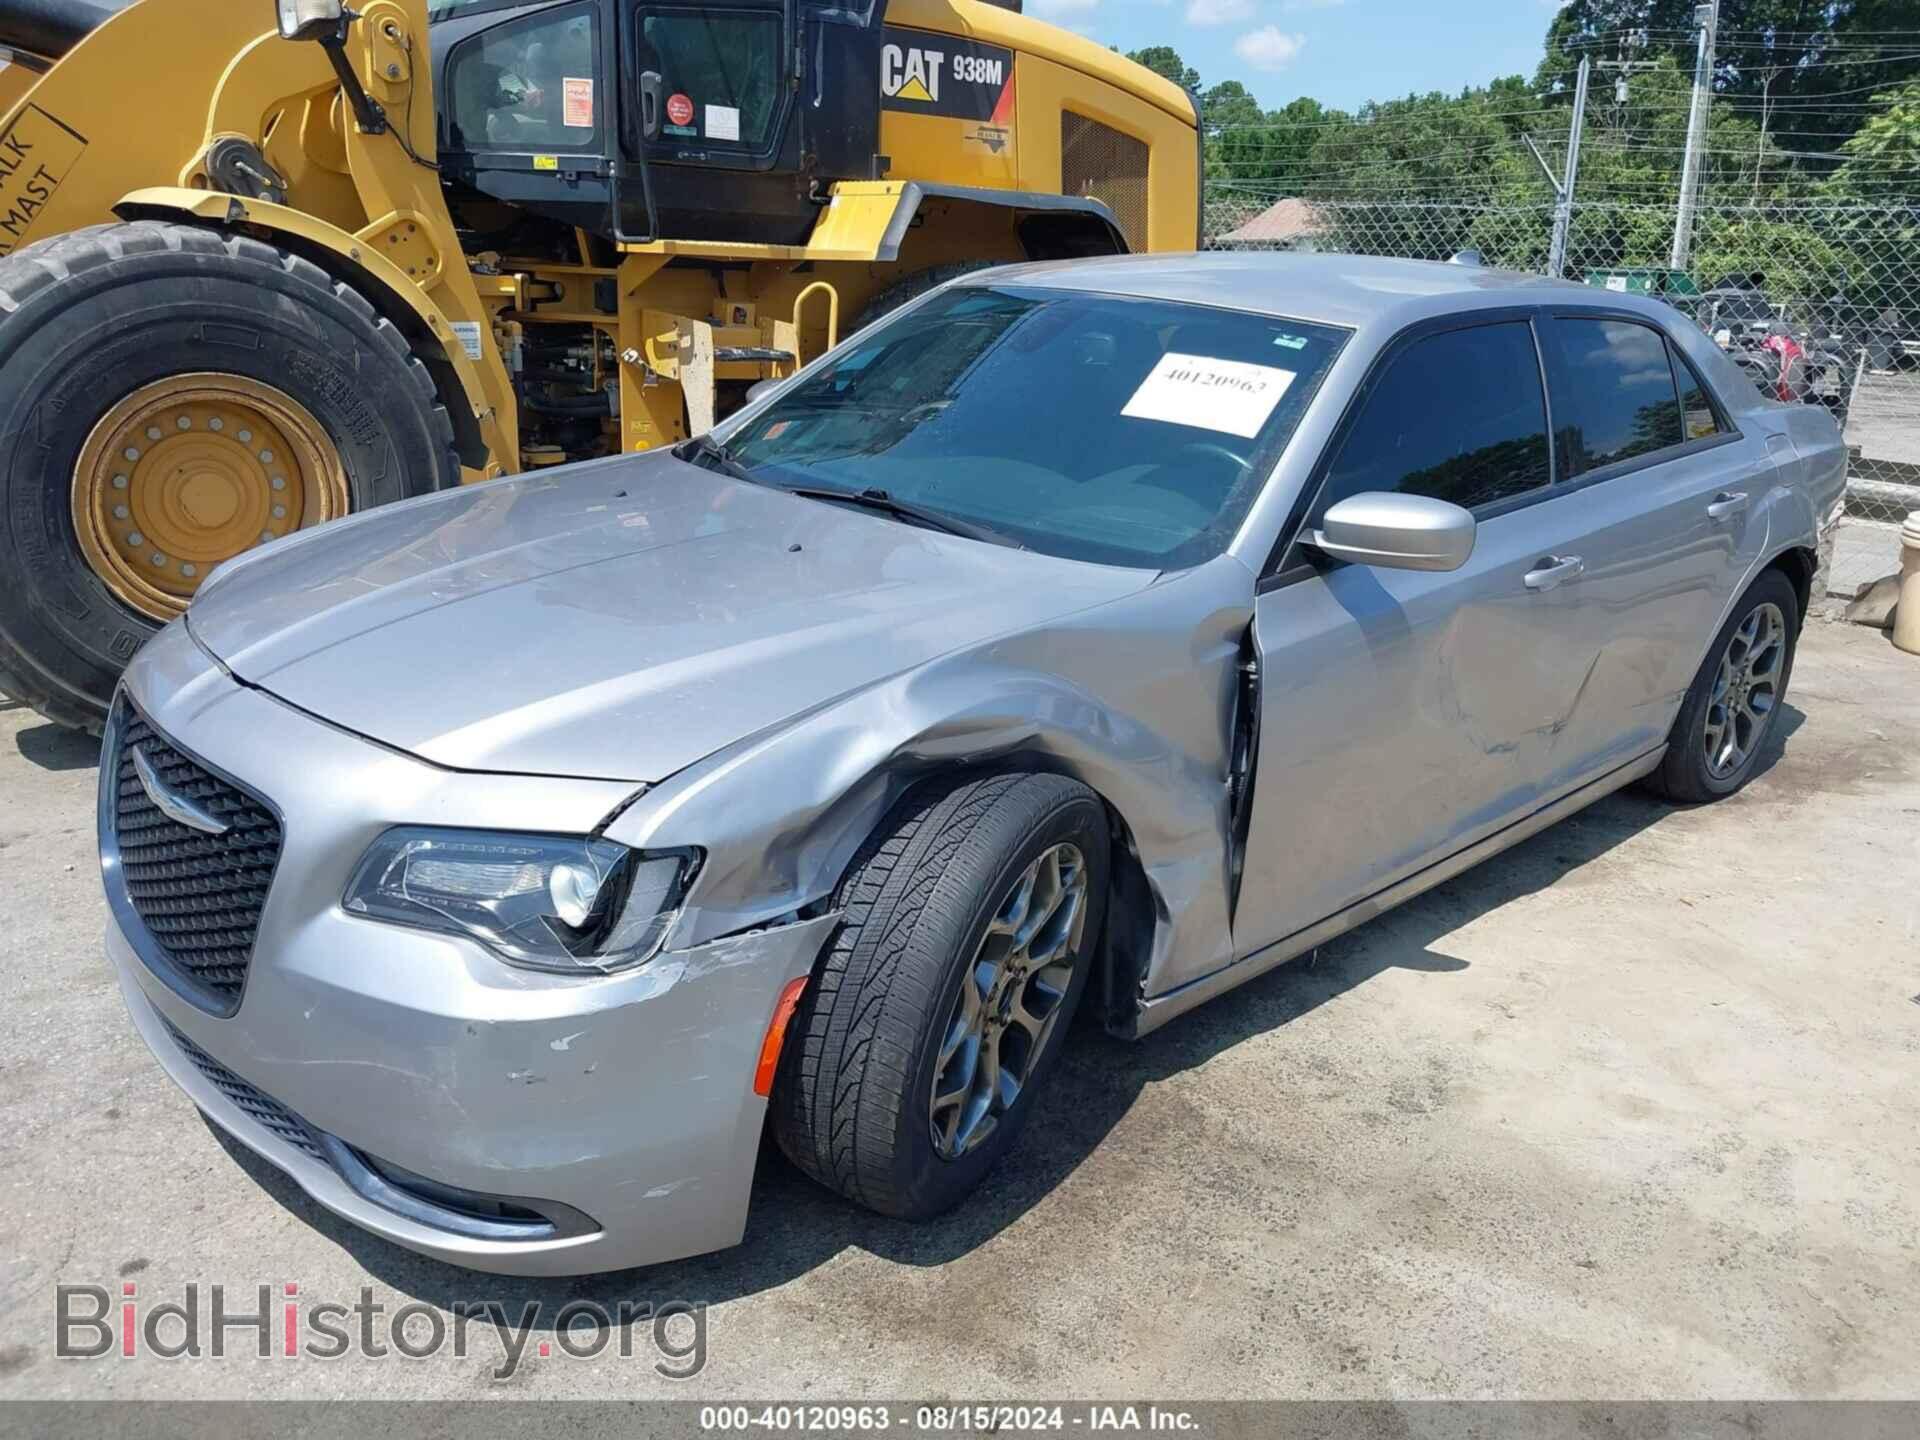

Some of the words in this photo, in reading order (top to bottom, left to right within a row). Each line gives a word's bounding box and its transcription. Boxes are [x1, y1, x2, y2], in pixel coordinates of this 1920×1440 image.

[881, 44, 945, 102] CAT
[953, 54, 1003, 86] 938M
[0, 163, 58, 237] MAST
